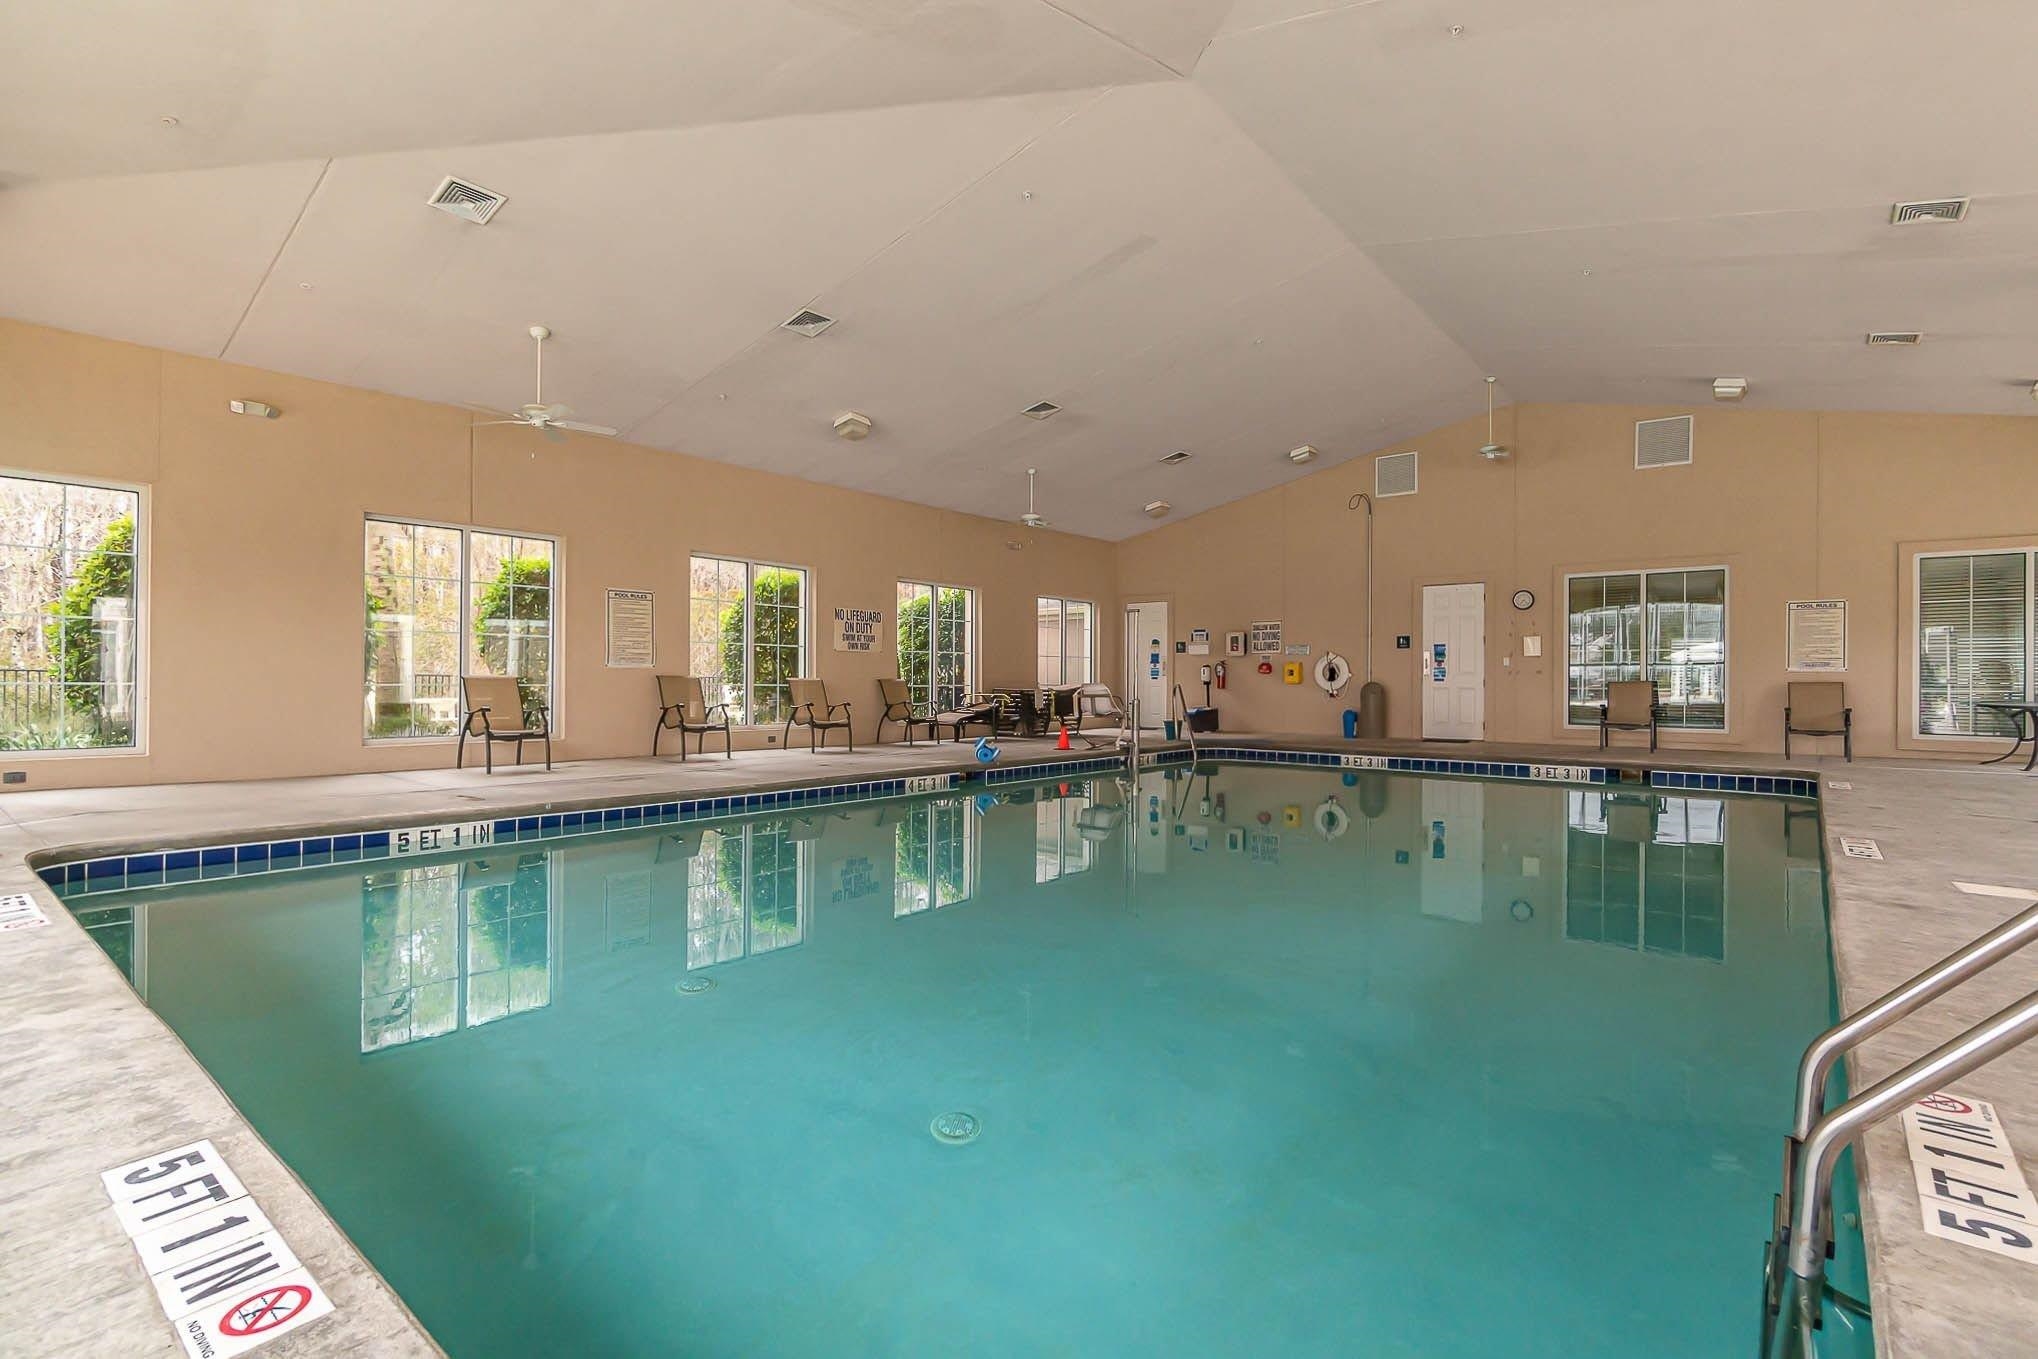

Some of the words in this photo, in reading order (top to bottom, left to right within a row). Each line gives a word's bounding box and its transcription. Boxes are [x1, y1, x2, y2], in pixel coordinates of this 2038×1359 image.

[835, 608, 845, 620] NO
[847, 609, 882, 623] LIFEGUARD
[845, 621, 854, 633] ON
[856, 622, 873, 634] DUTY
[1253, 641, 1280, 651] ALLOWED
[1262, 631, 1281, 640] DIVING
[452, 827, 461, 846] 1
[1916, 1111, 1998, 1148] IN
[123, 1150, 206, 1185] 5
[1923, 1144, 2005, 1170] 1
[132, 1173, 230, 1223] FT
[1931, 1168, 2026, 1219] FT
[160, 1215, 250, 1254] 1
[1938, 1209, 2033, 1248] 5
[173, 1240, 281, 1306] IN
[187, 1320, 202, 1333] NO
[193, 1332, 216, 1359] DIVING
